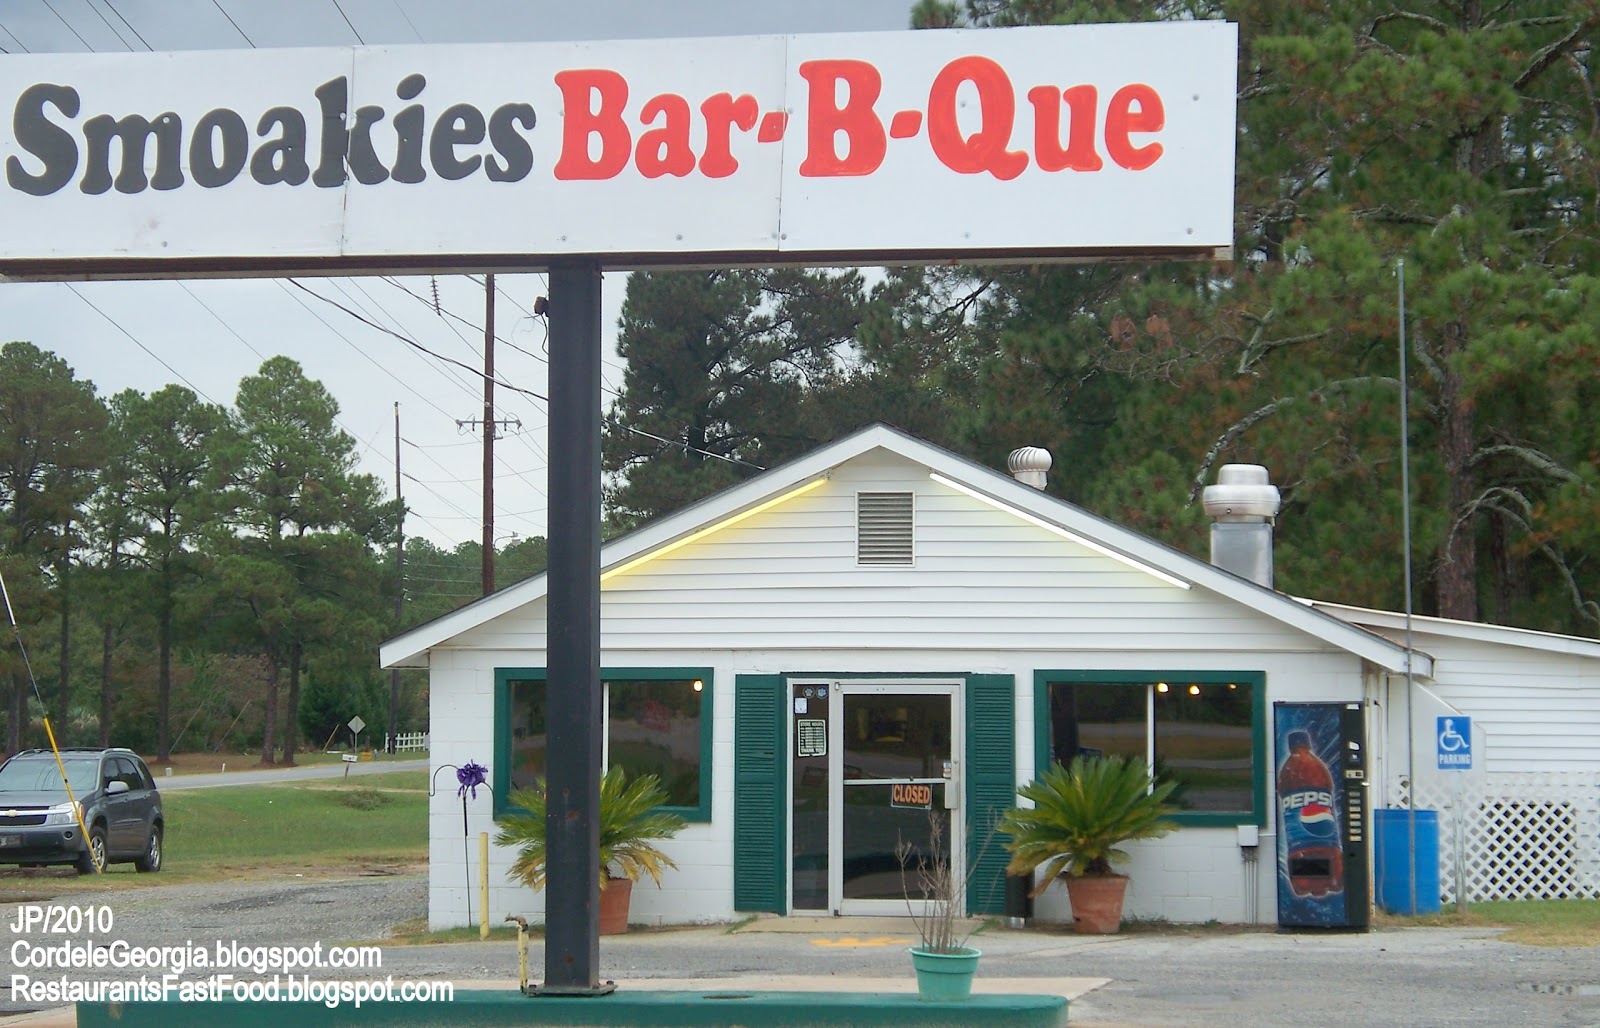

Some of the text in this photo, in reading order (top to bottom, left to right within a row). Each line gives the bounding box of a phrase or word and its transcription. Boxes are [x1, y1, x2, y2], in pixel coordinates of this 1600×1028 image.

[5, 73, 537, 197] Smoakies
[1439, 753, 1471, 765] PARKING
[893, 783, 930, 804] CLOSED
[1282, 791, 1333, 810] PEPSI
